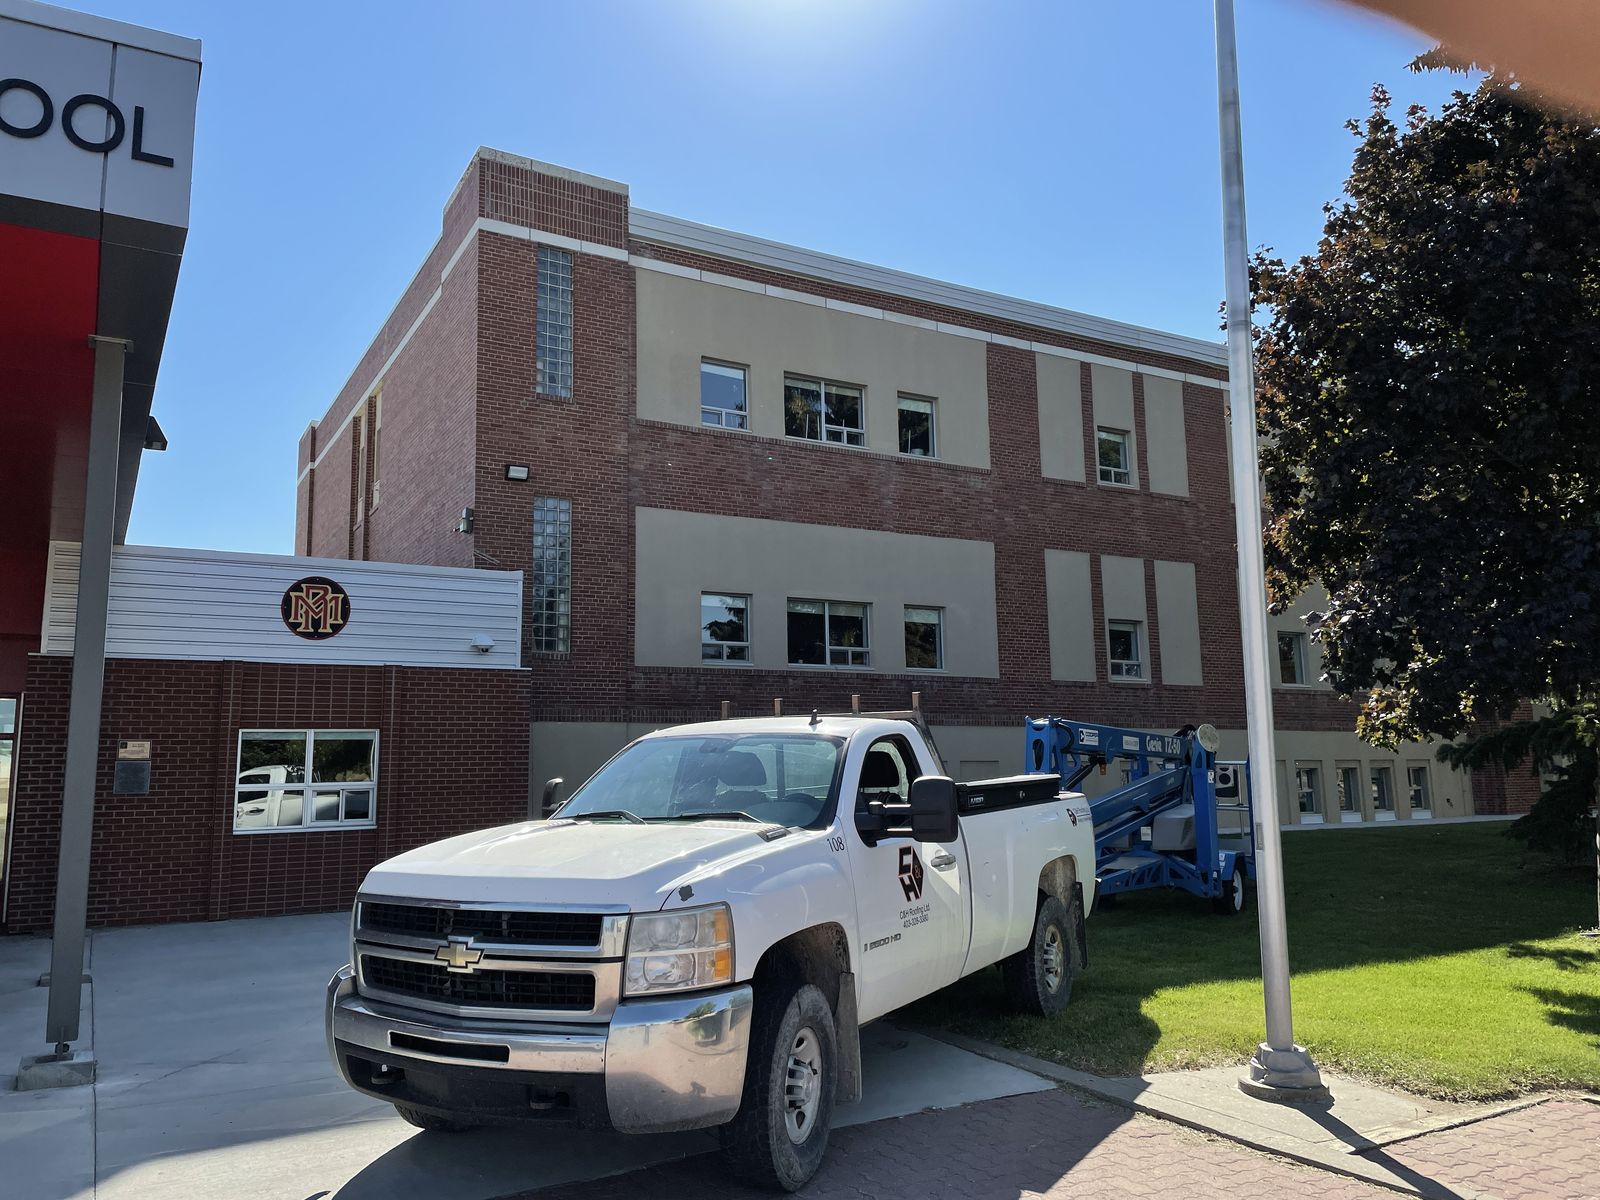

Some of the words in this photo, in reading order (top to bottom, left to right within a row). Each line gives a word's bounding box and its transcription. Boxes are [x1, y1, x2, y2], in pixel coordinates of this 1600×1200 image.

[0, 78, 175, 169] OOL
[826, 836, 845, 852] 108
[890, 932, 902, 944] HD
